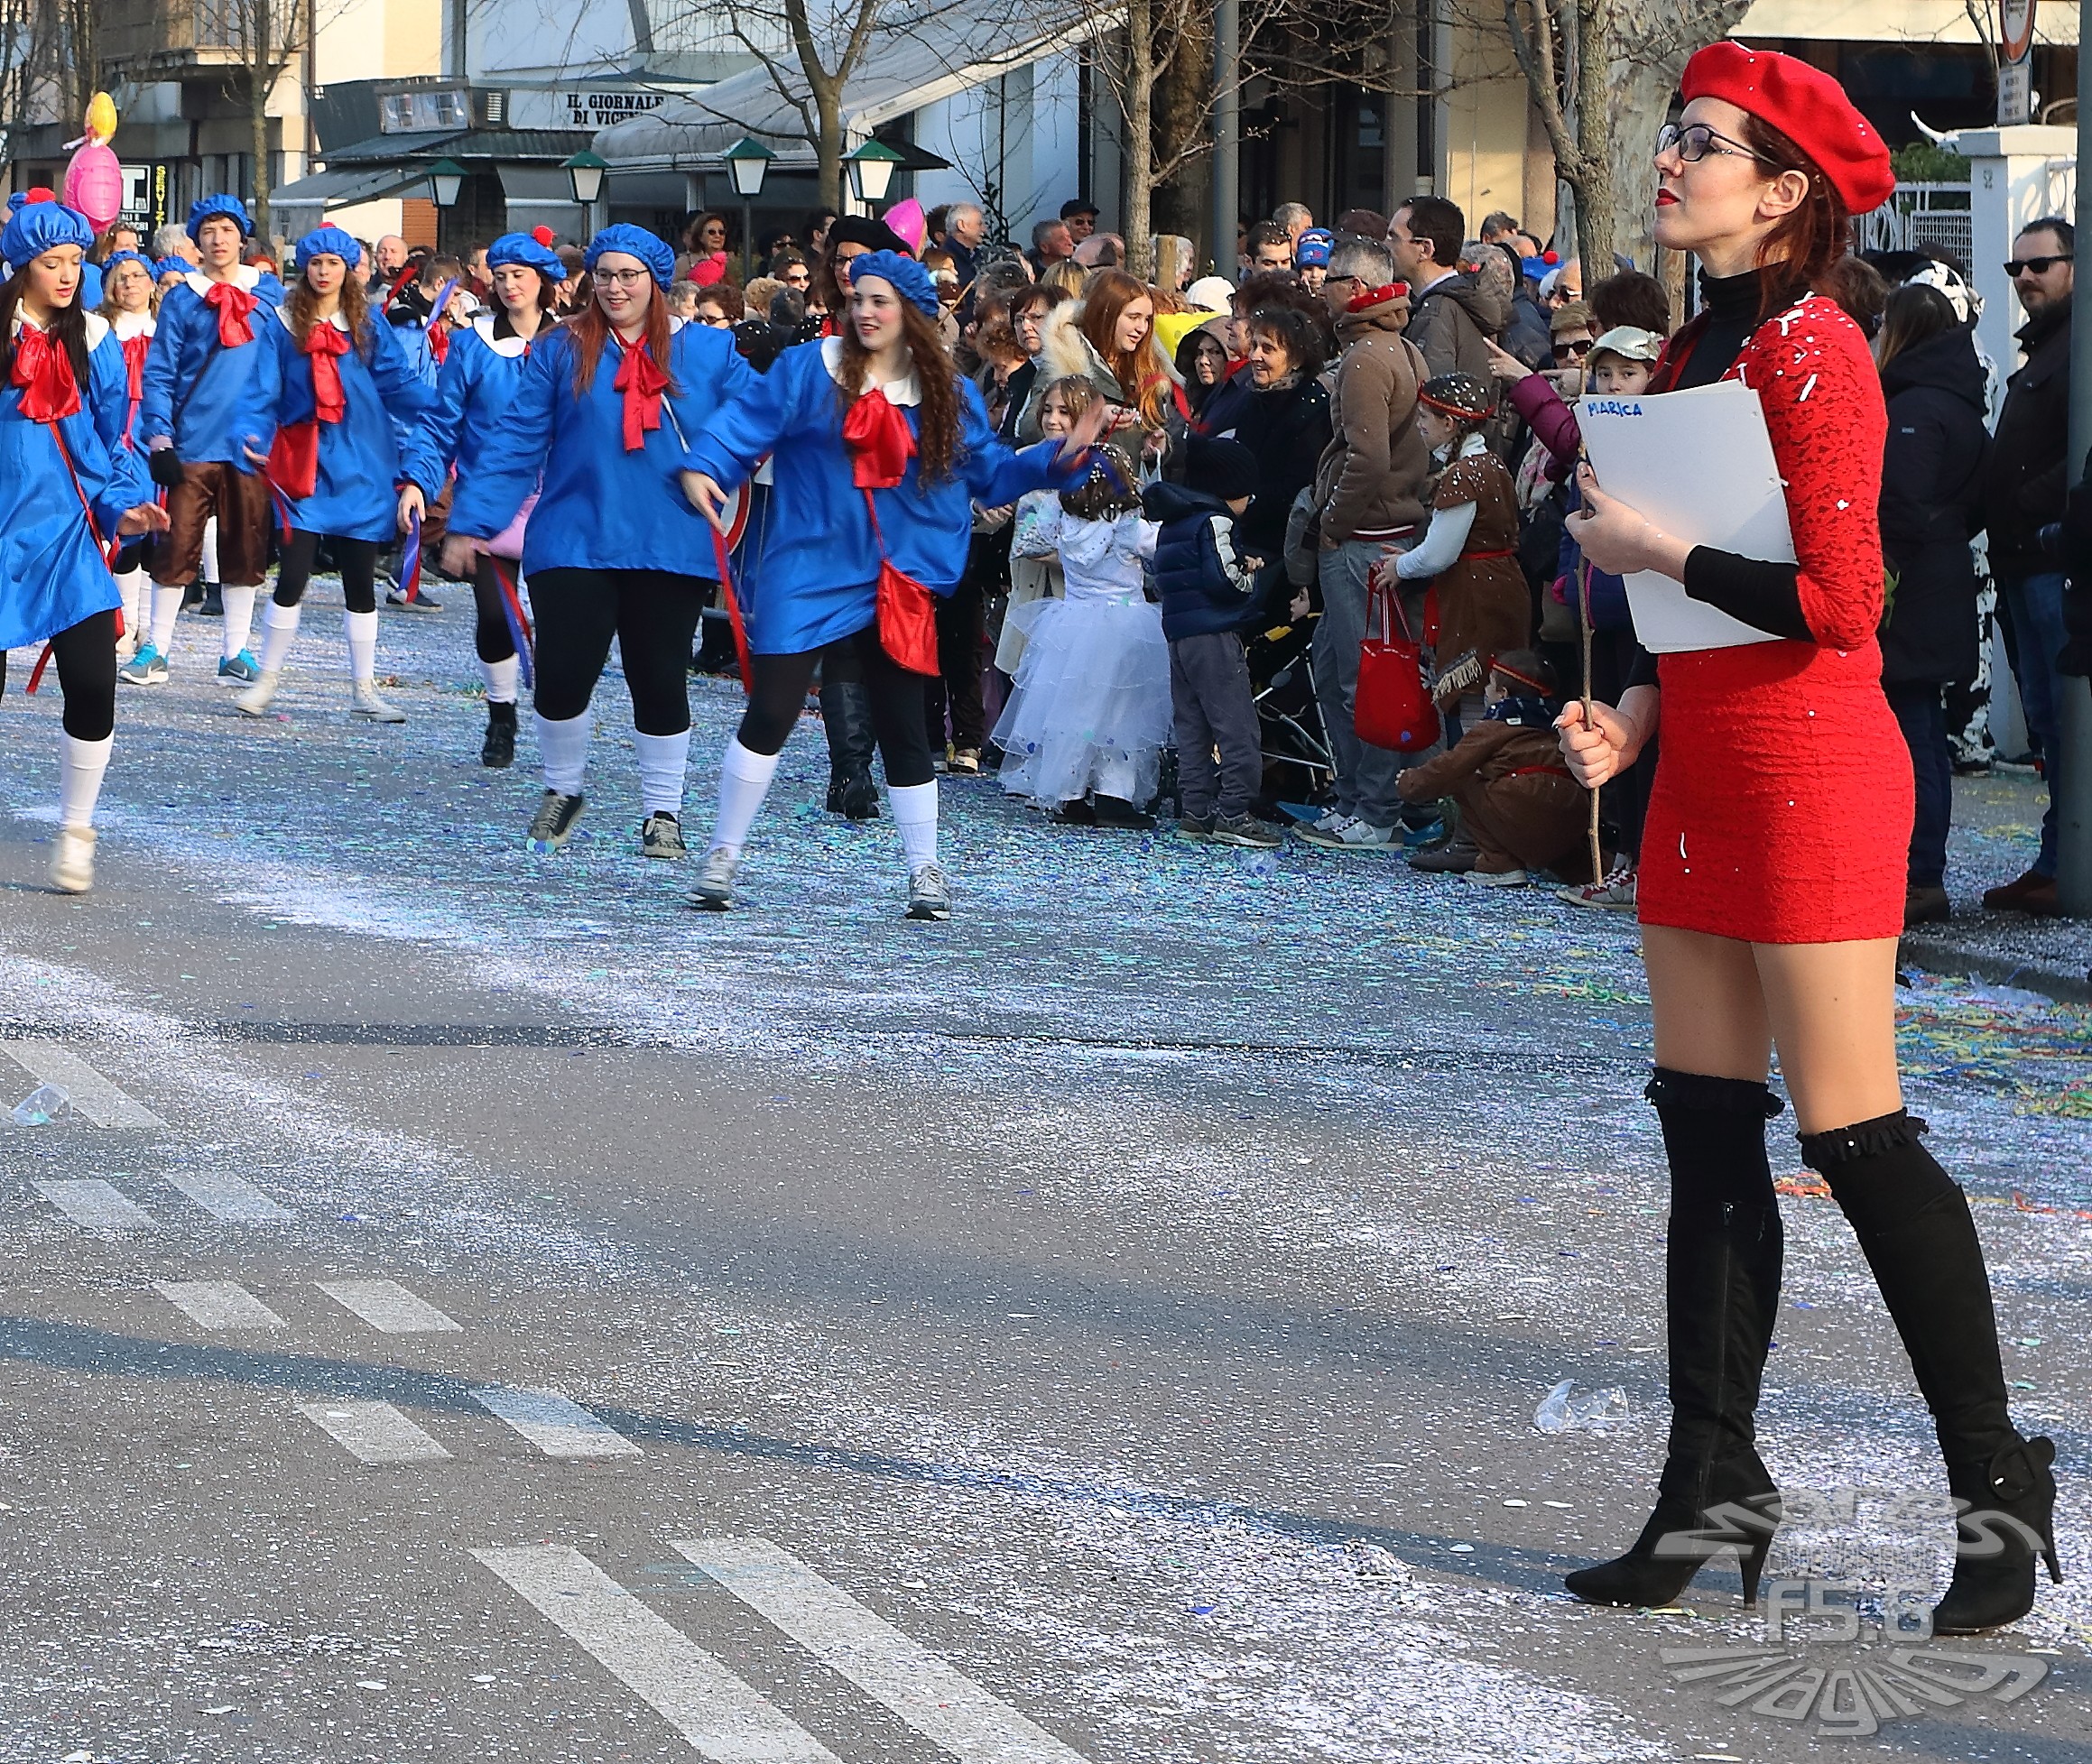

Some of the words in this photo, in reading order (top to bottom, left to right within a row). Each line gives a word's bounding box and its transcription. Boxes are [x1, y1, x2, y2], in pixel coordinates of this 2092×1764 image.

[567, 94, 582, 108] IL
[588, 94, 664, 110] GIORNALE
[573, 110, 588, 125] DI
[1588, 402, 1643, 417] MARICA
